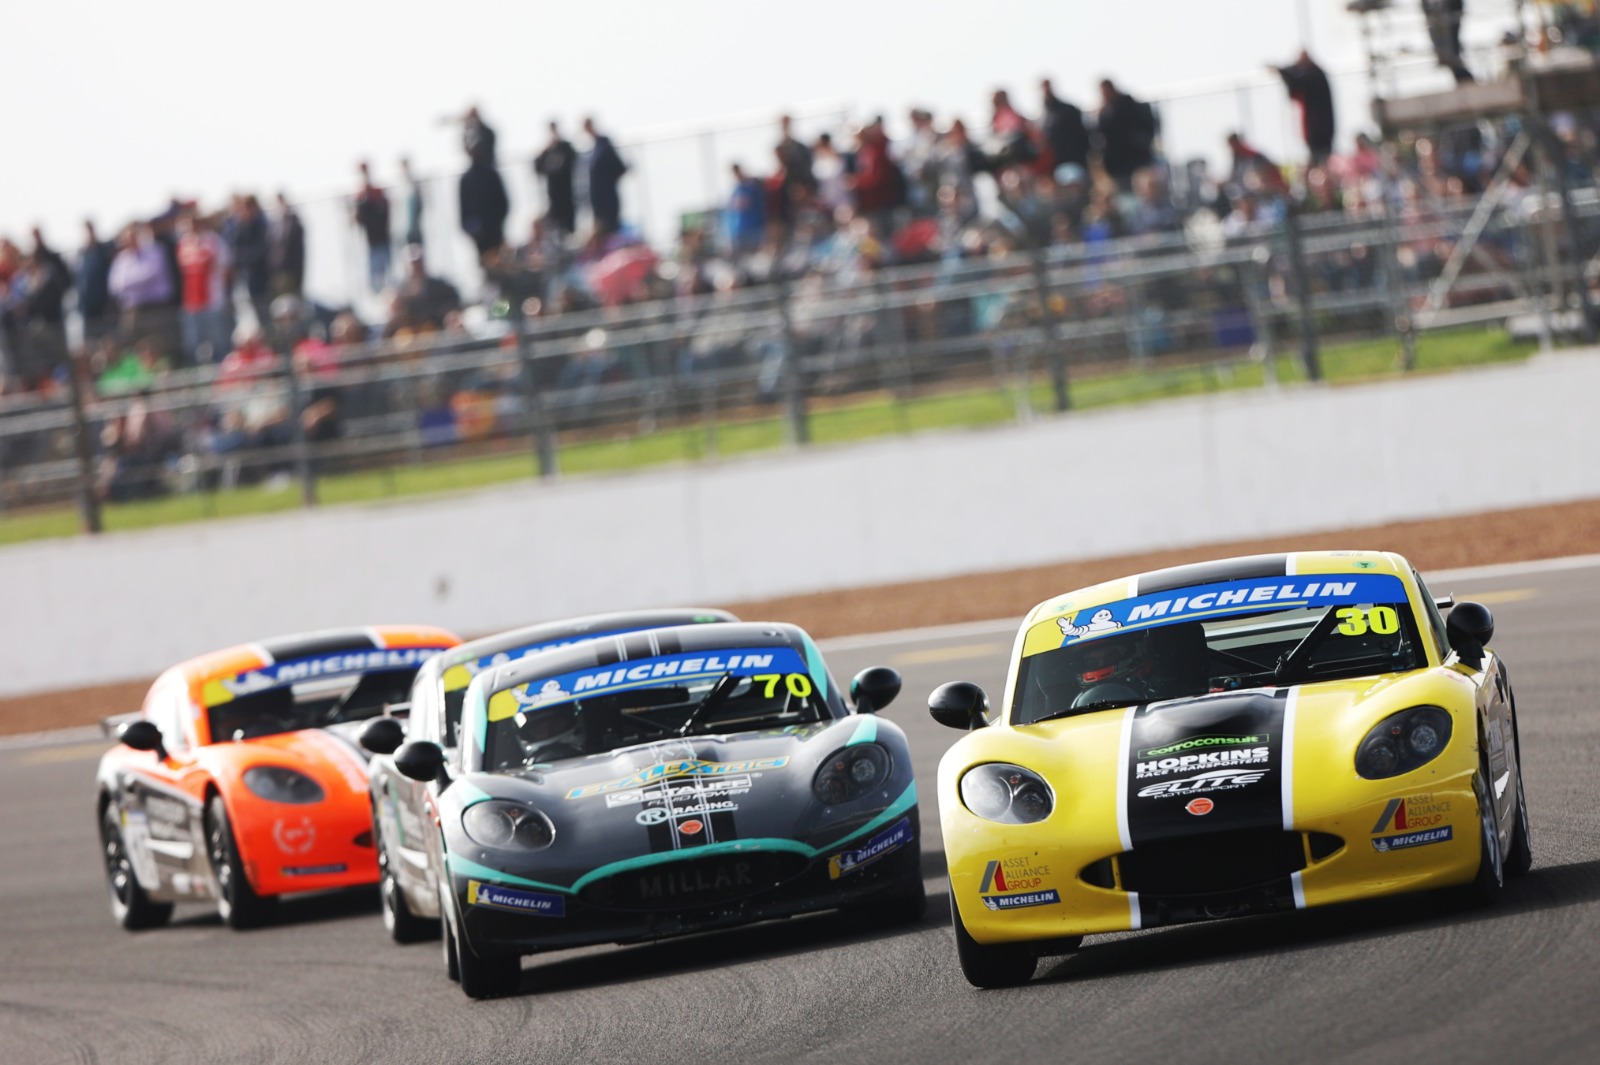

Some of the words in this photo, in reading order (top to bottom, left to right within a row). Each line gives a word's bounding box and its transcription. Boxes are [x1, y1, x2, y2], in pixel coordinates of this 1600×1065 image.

[1127, 582, 1357, 622] MICHELIN
[1335, 606, 1399, 636] 30
[573, 654, 774, 692] MICHELIN
[753, 672, 812, 698] 70
[1147, 736, 1259, 756] corroconsult
[1136, 747, 1270, 773] HOPKINS
[1136, 769, 1168, 779] RACE
[1172, 757, 1269, 774] TRANSPORTERS
[643, 778, 749, 801] STAUFF
[1137, 770, 1267, 797] ELITE
[1153, 784, 1248, 799] MOTORSPORT
[692, 788, 750, 800] POWER
[1407, 793, 1434, 805] ASSET
[1407, 801, 1451, 816] ALLIANCE
[1407, 814, 1442, 828] GROUP
[857, 829, 904, 861] MICHELIN
[1392, 828, 1449, 846] MICHELIN
[1003, 857, 1030, 868] ASSET
[1005, 865, 1051, 879] ALLIANCE
[640, 862, 752, 898] MILLAR
[1007, 877, 1042, 890] GROUP
[492, 894, 552, 909] MICHELIN
[999, 892, 1054, 906] MICHELIN
